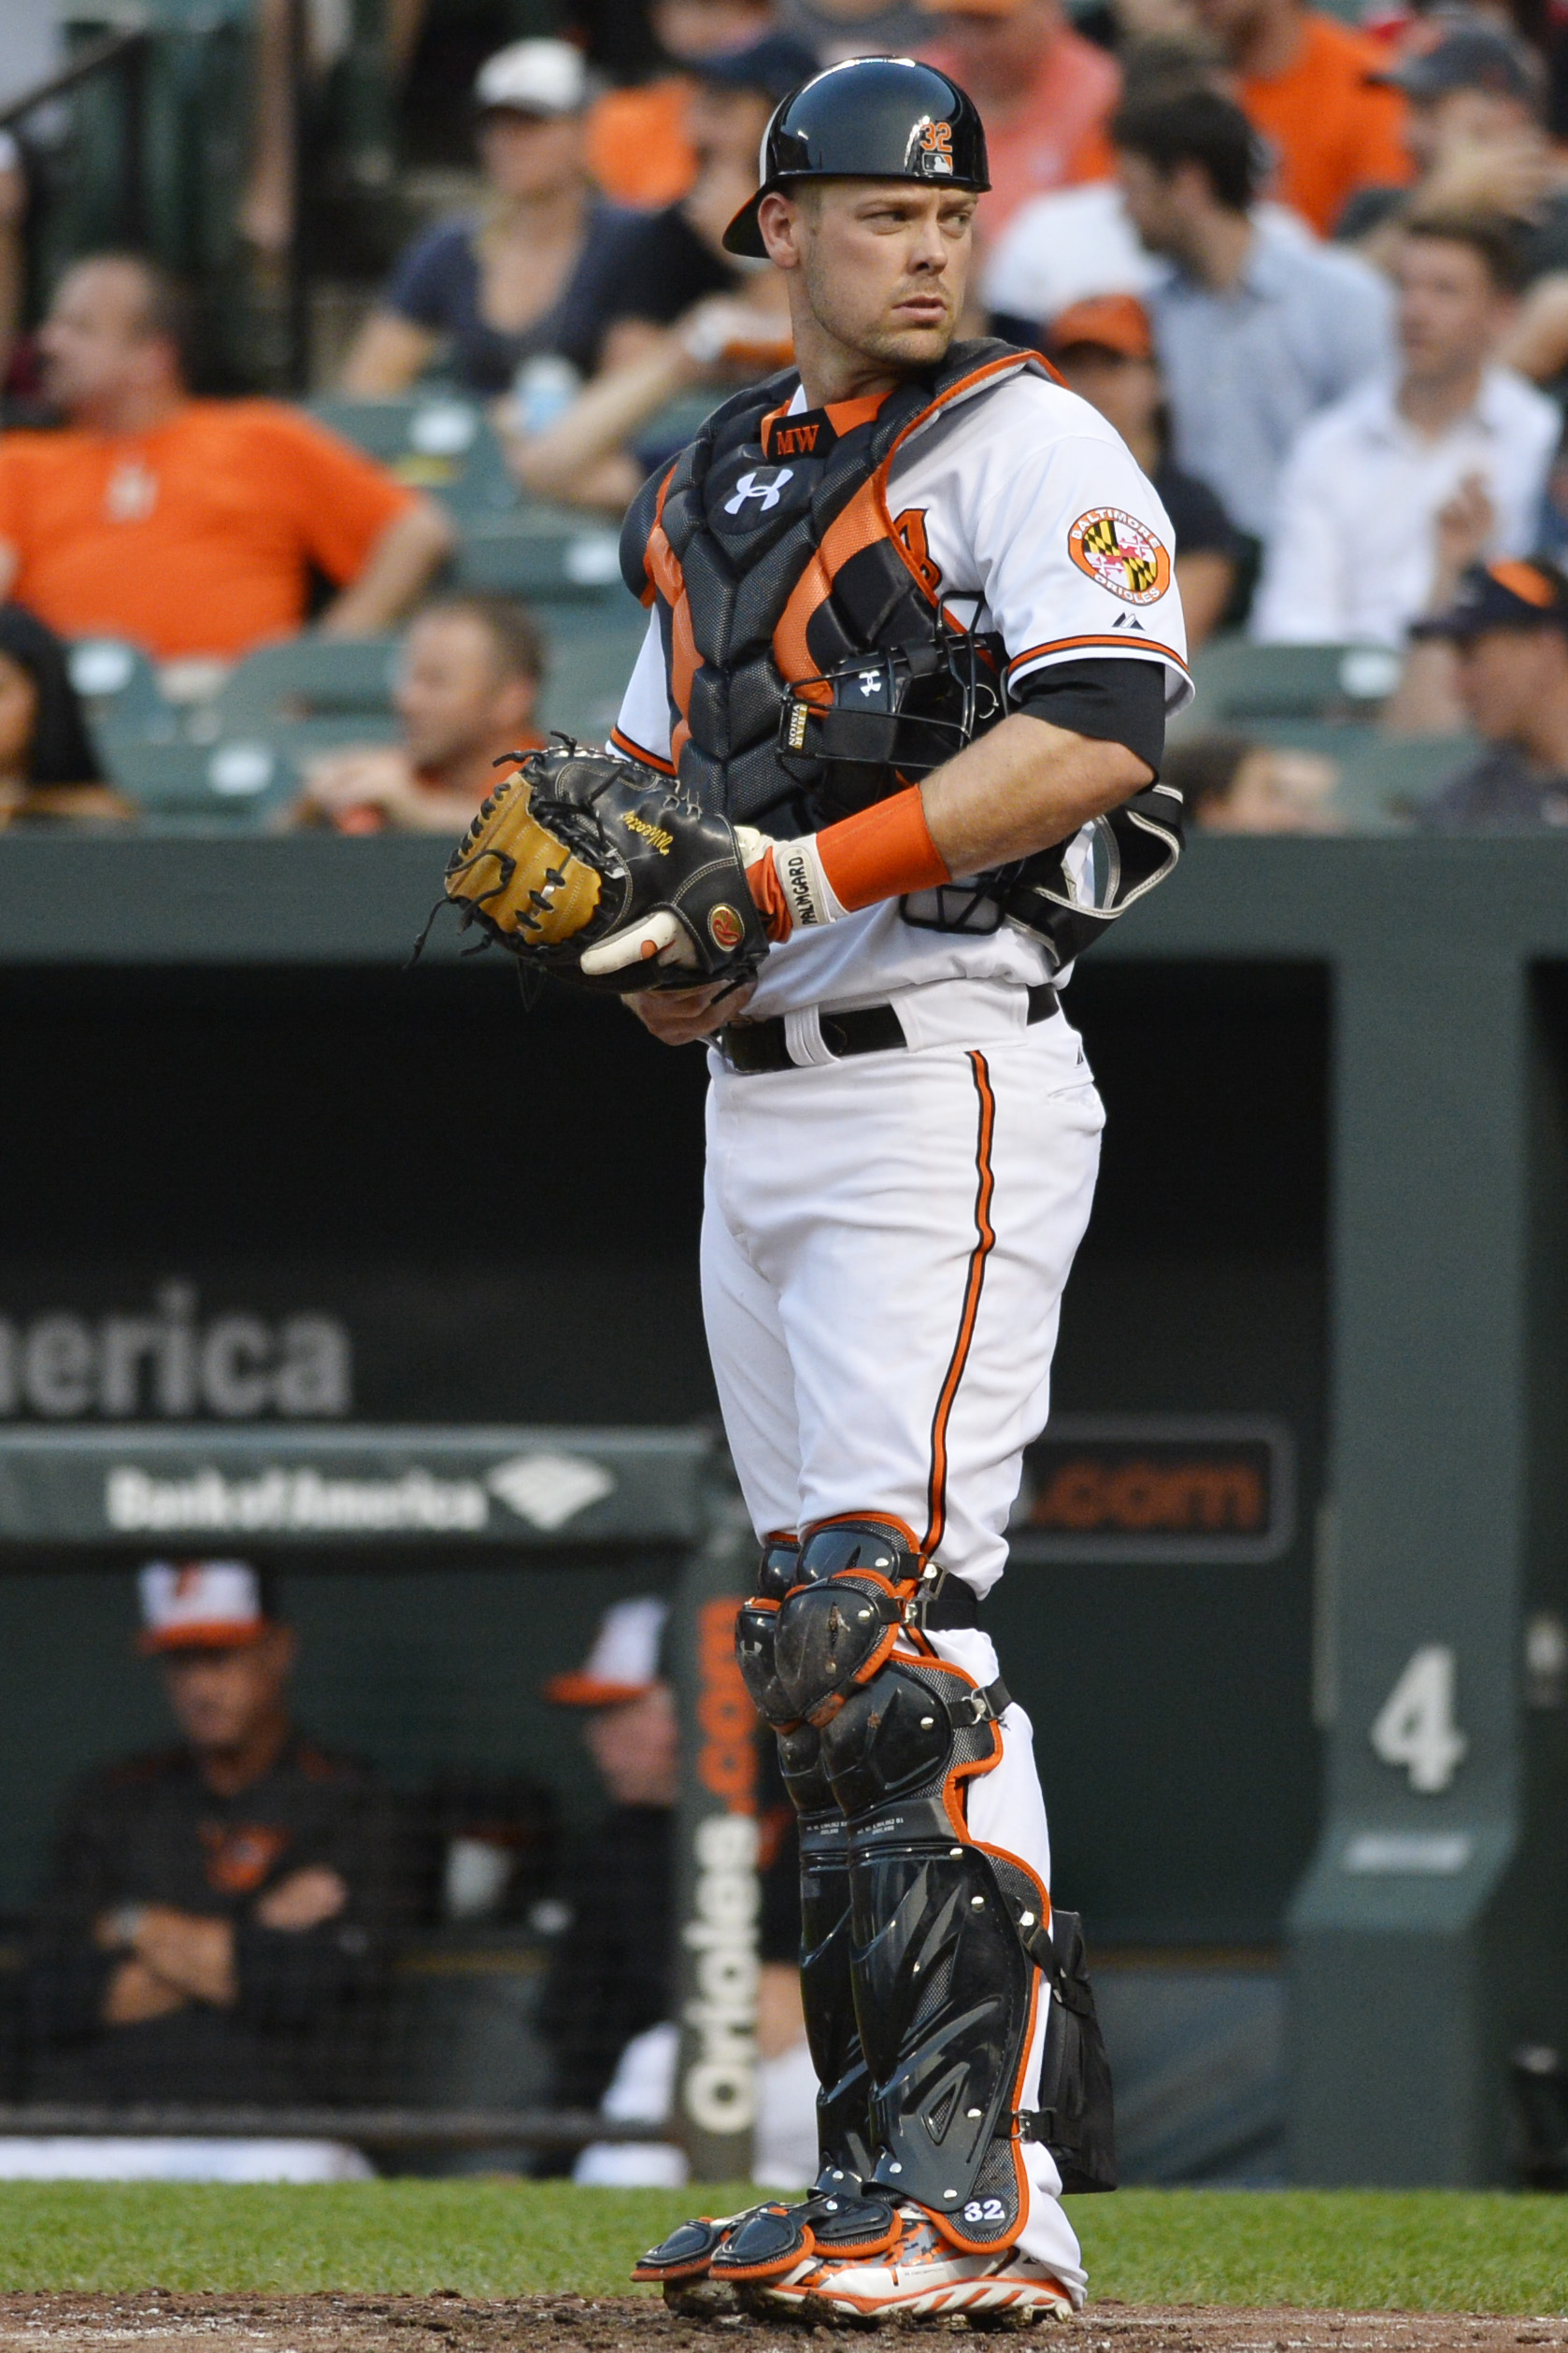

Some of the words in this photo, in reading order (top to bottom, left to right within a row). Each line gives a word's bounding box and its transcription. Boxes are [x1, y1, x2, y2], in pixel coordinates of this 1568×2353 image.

[919, 121, 953, 152] 32
[776, 424, 820, 455] MW
[1071, 507, 1162, 549] BALTIMORE
[1093, 573, 1162, 605] ORIOLES
[788, 704, 801, 746] VISION
[787, 856, 818, 925] PALMGARD
[107, 1465, 225, 1531] Bank
[235, 1465, 287, 1531] of
[291, 1465, 489, 1531] America
[1371, 1644, 1467, 1792] 4
[962, 2198, 1005, 2222] 32
